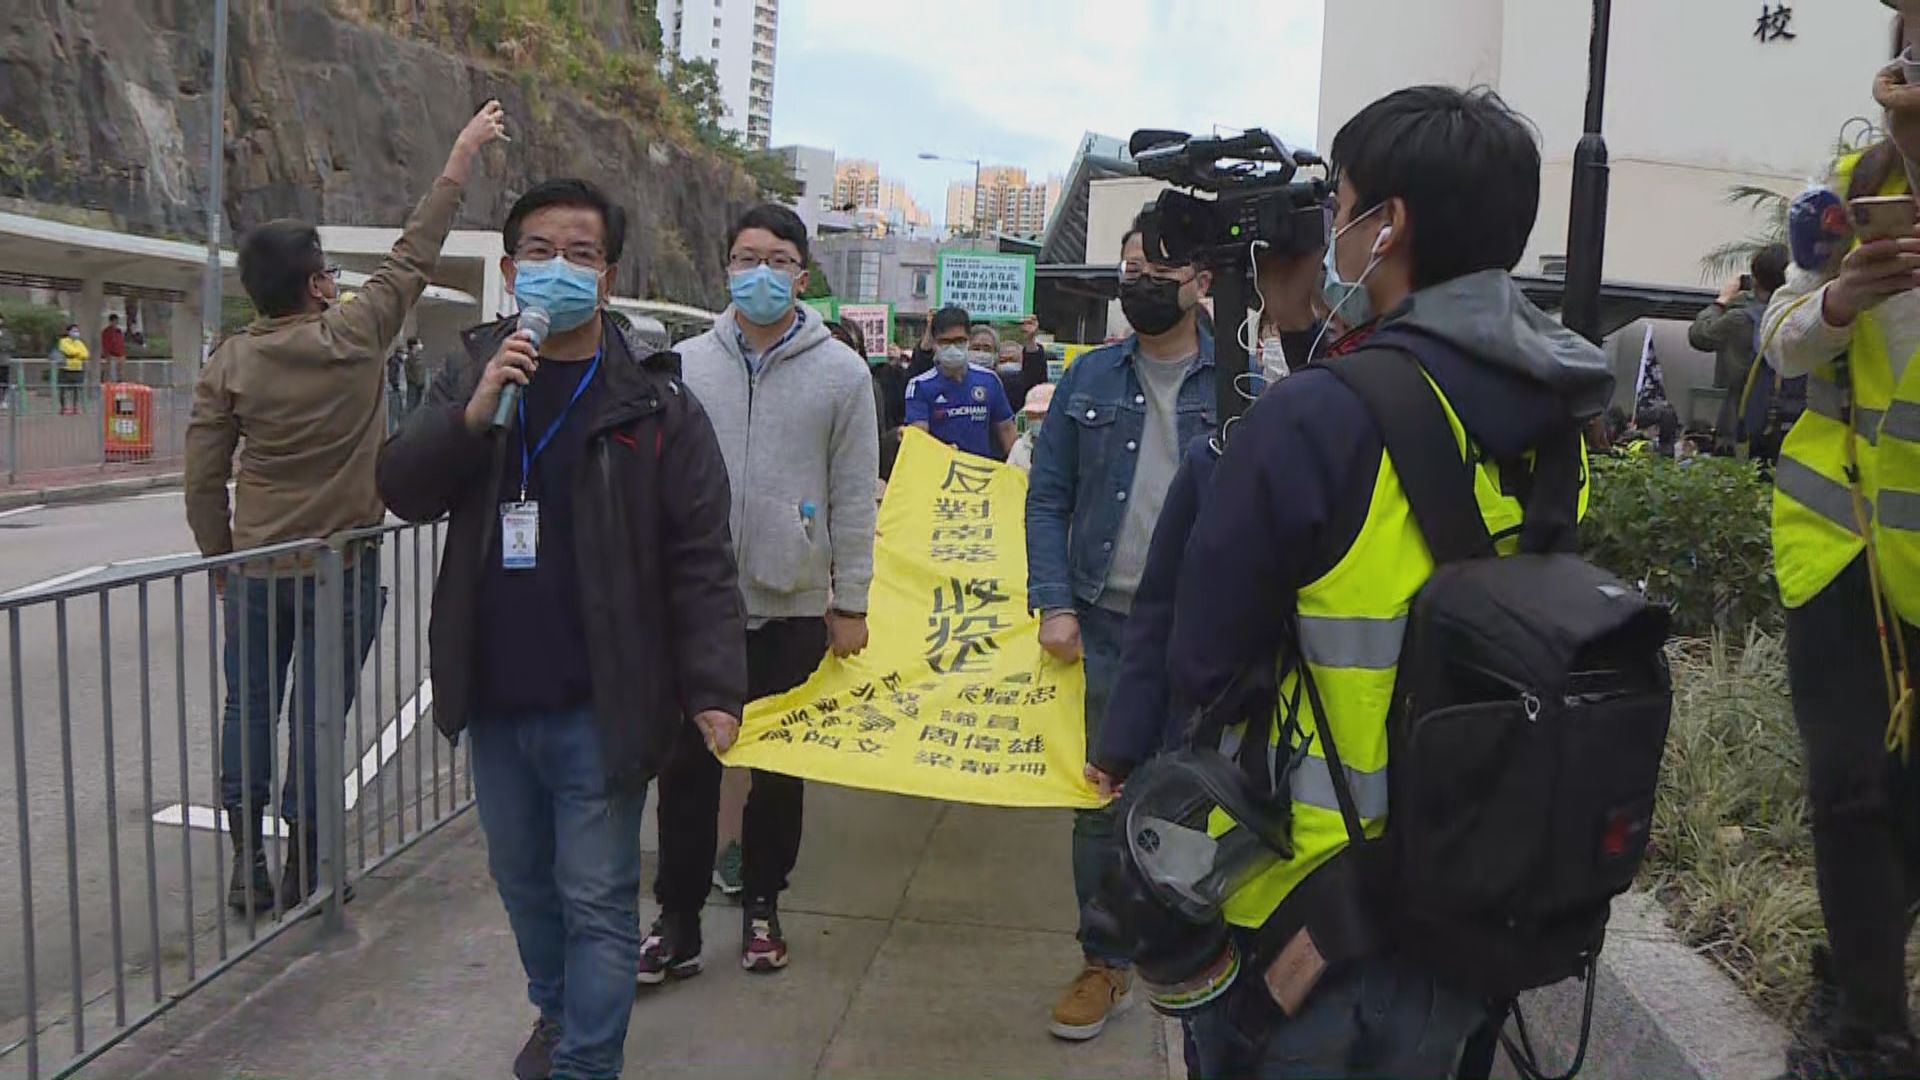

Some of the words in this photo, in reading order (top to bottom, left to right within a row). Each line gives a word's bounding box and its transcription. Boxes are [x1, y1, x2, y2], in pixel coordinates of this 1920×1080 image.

[1753, 4, 1797, 43] 校
[946, 406, 988, 416] YOKOHAMA
[919, 724, 1048, 754] 周偉雄
